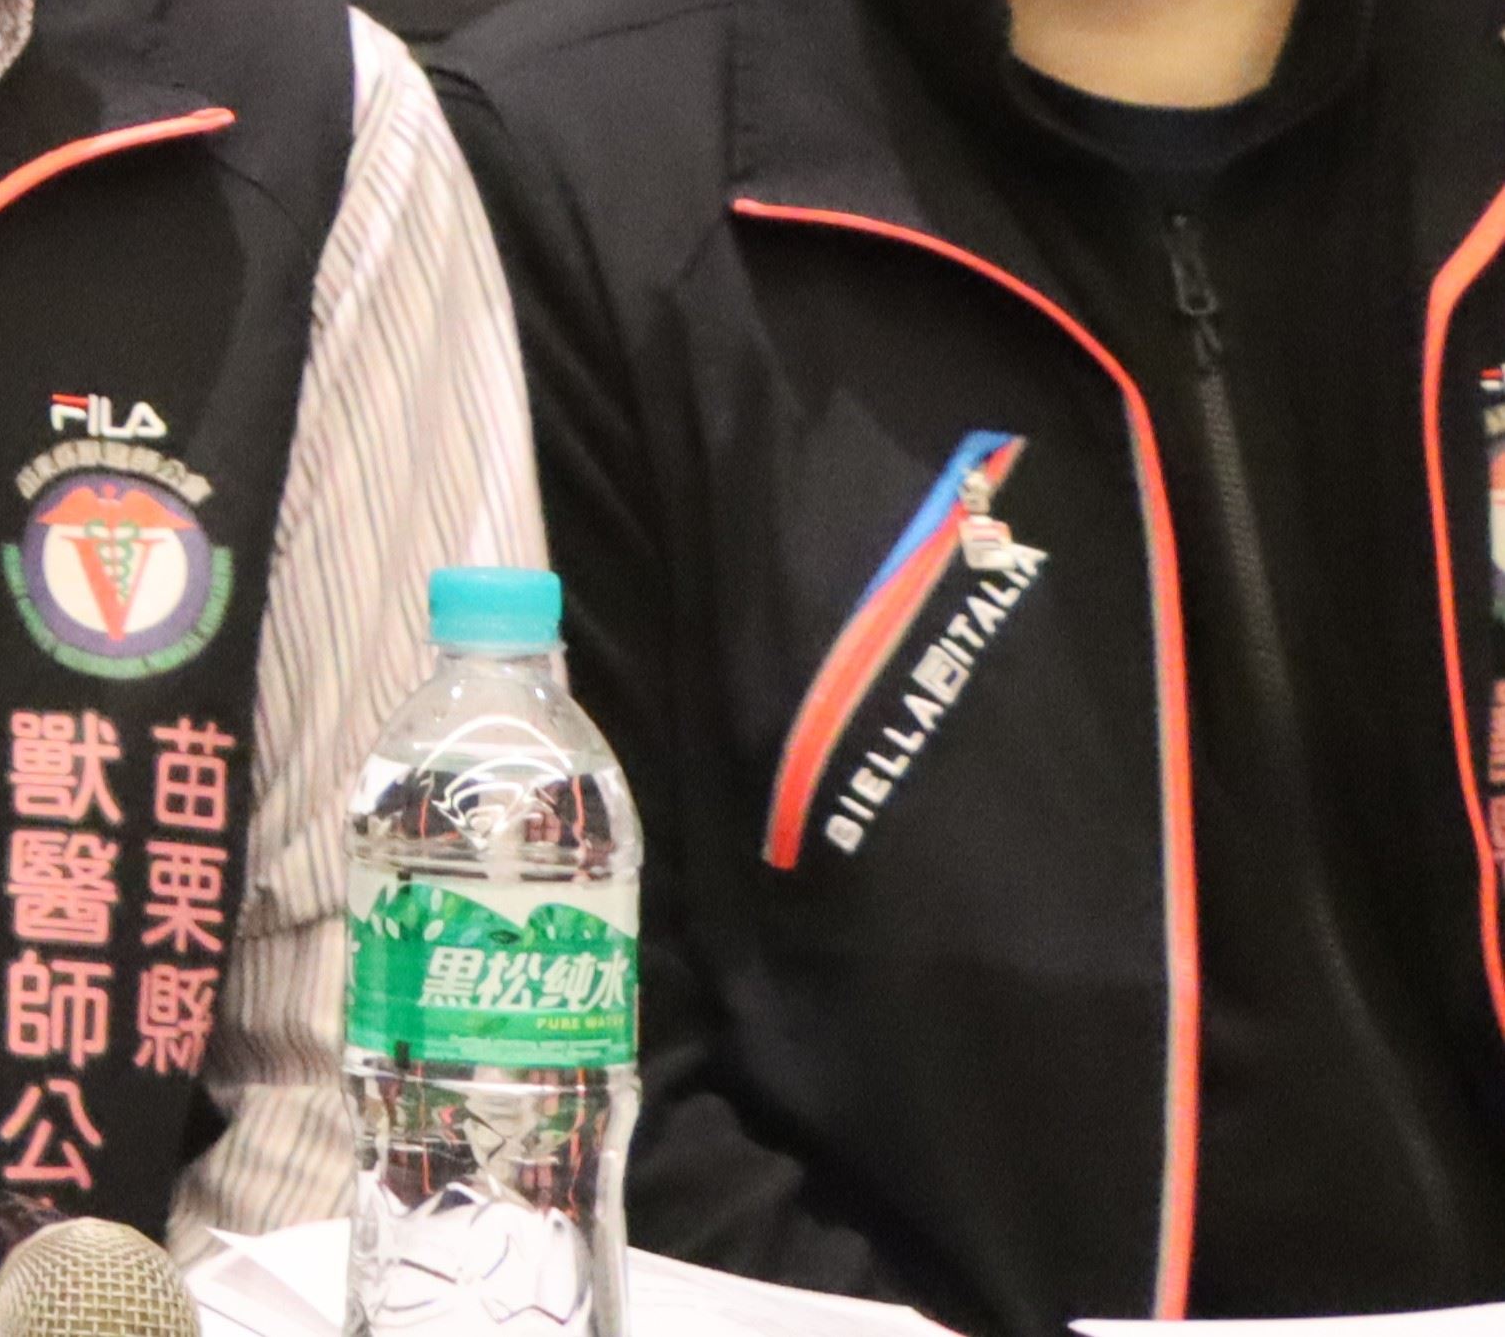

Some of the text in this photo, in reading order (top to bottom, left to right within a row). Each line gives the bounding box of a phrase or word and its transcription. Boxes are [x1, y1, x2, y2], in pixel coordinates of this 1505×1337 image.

[50, 393, 167, 438] FILA
[825, 694, 945, 854] BIELLA
[134, 716, 236, 1076] 苗栗縣
